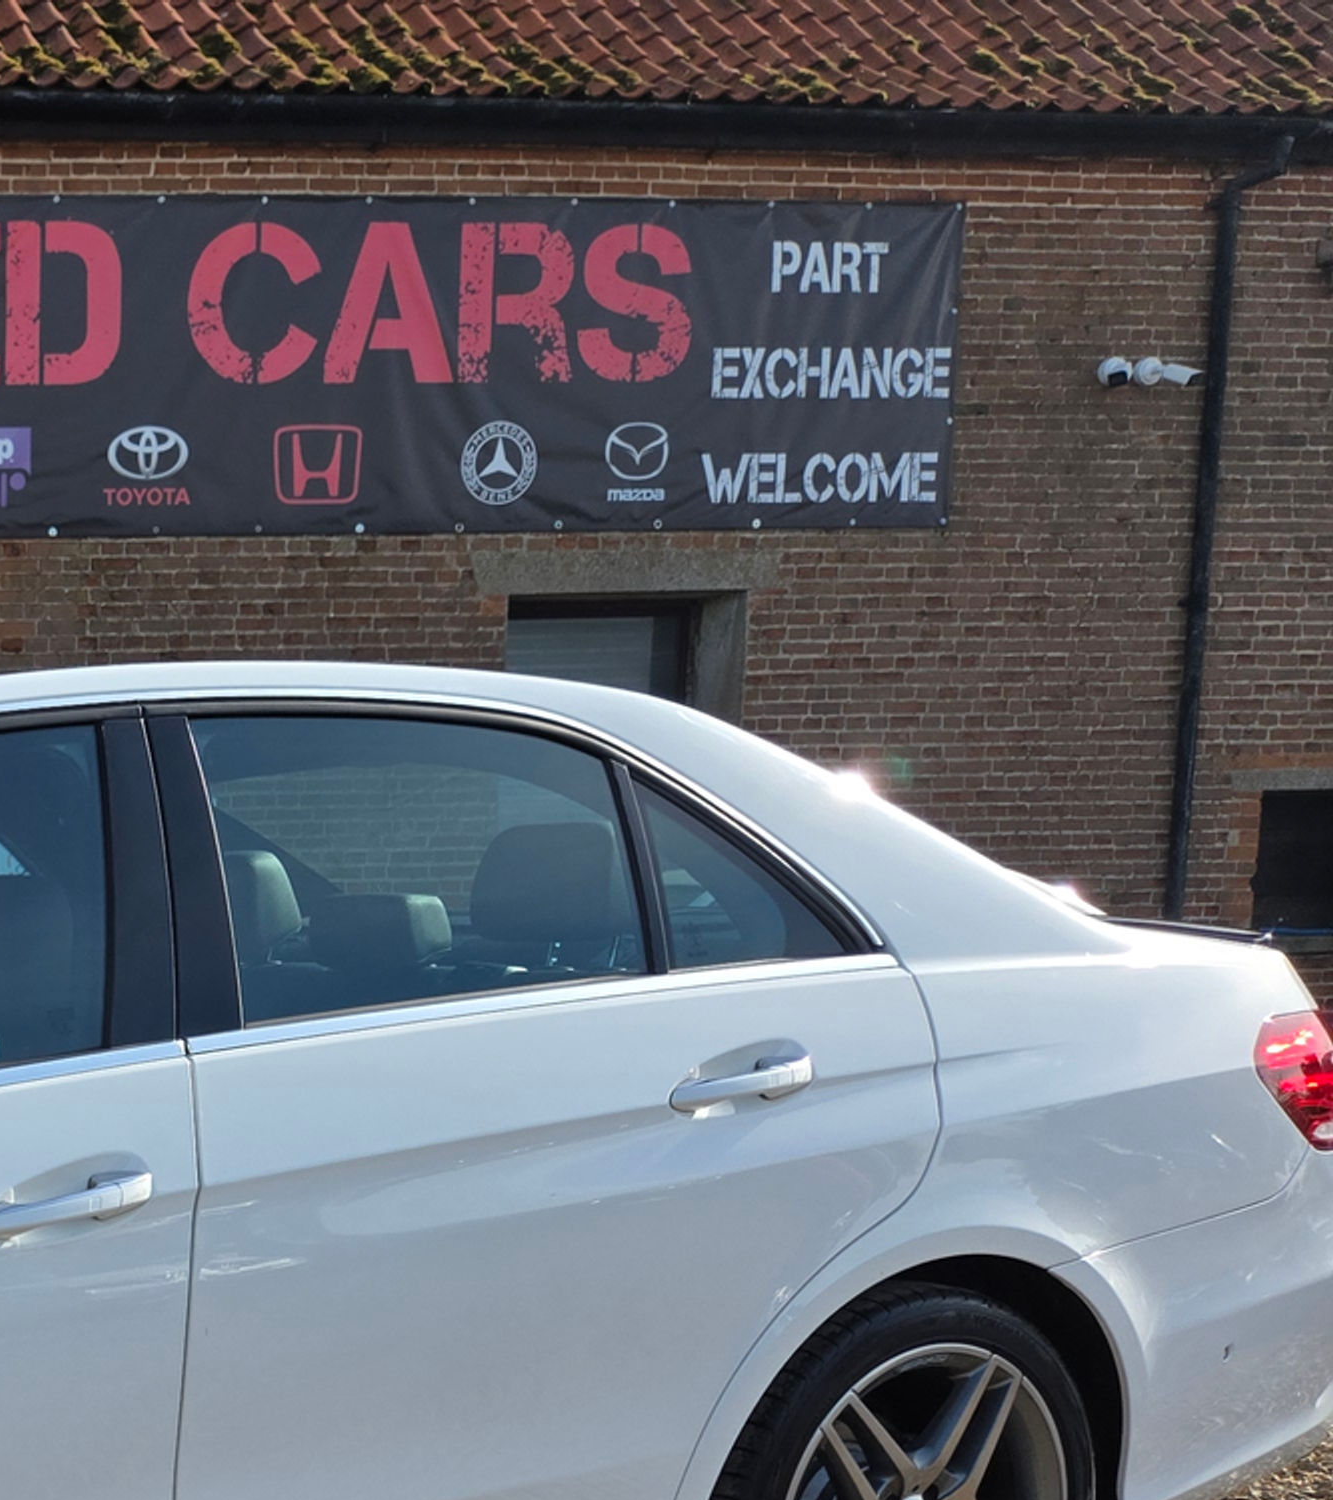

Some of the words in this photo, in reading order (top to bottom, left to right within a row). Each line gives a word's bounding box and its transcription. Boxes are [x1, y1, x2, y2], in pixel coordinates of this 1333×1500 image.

[771, 240, 889, 293] PART
[187, 221, 692, 384] CARS
[711, 347, 952, 399] EXCHANGE
[102, 487, 191, 507] TOYOTA
[701, 452, 939, 503] WELCOME
